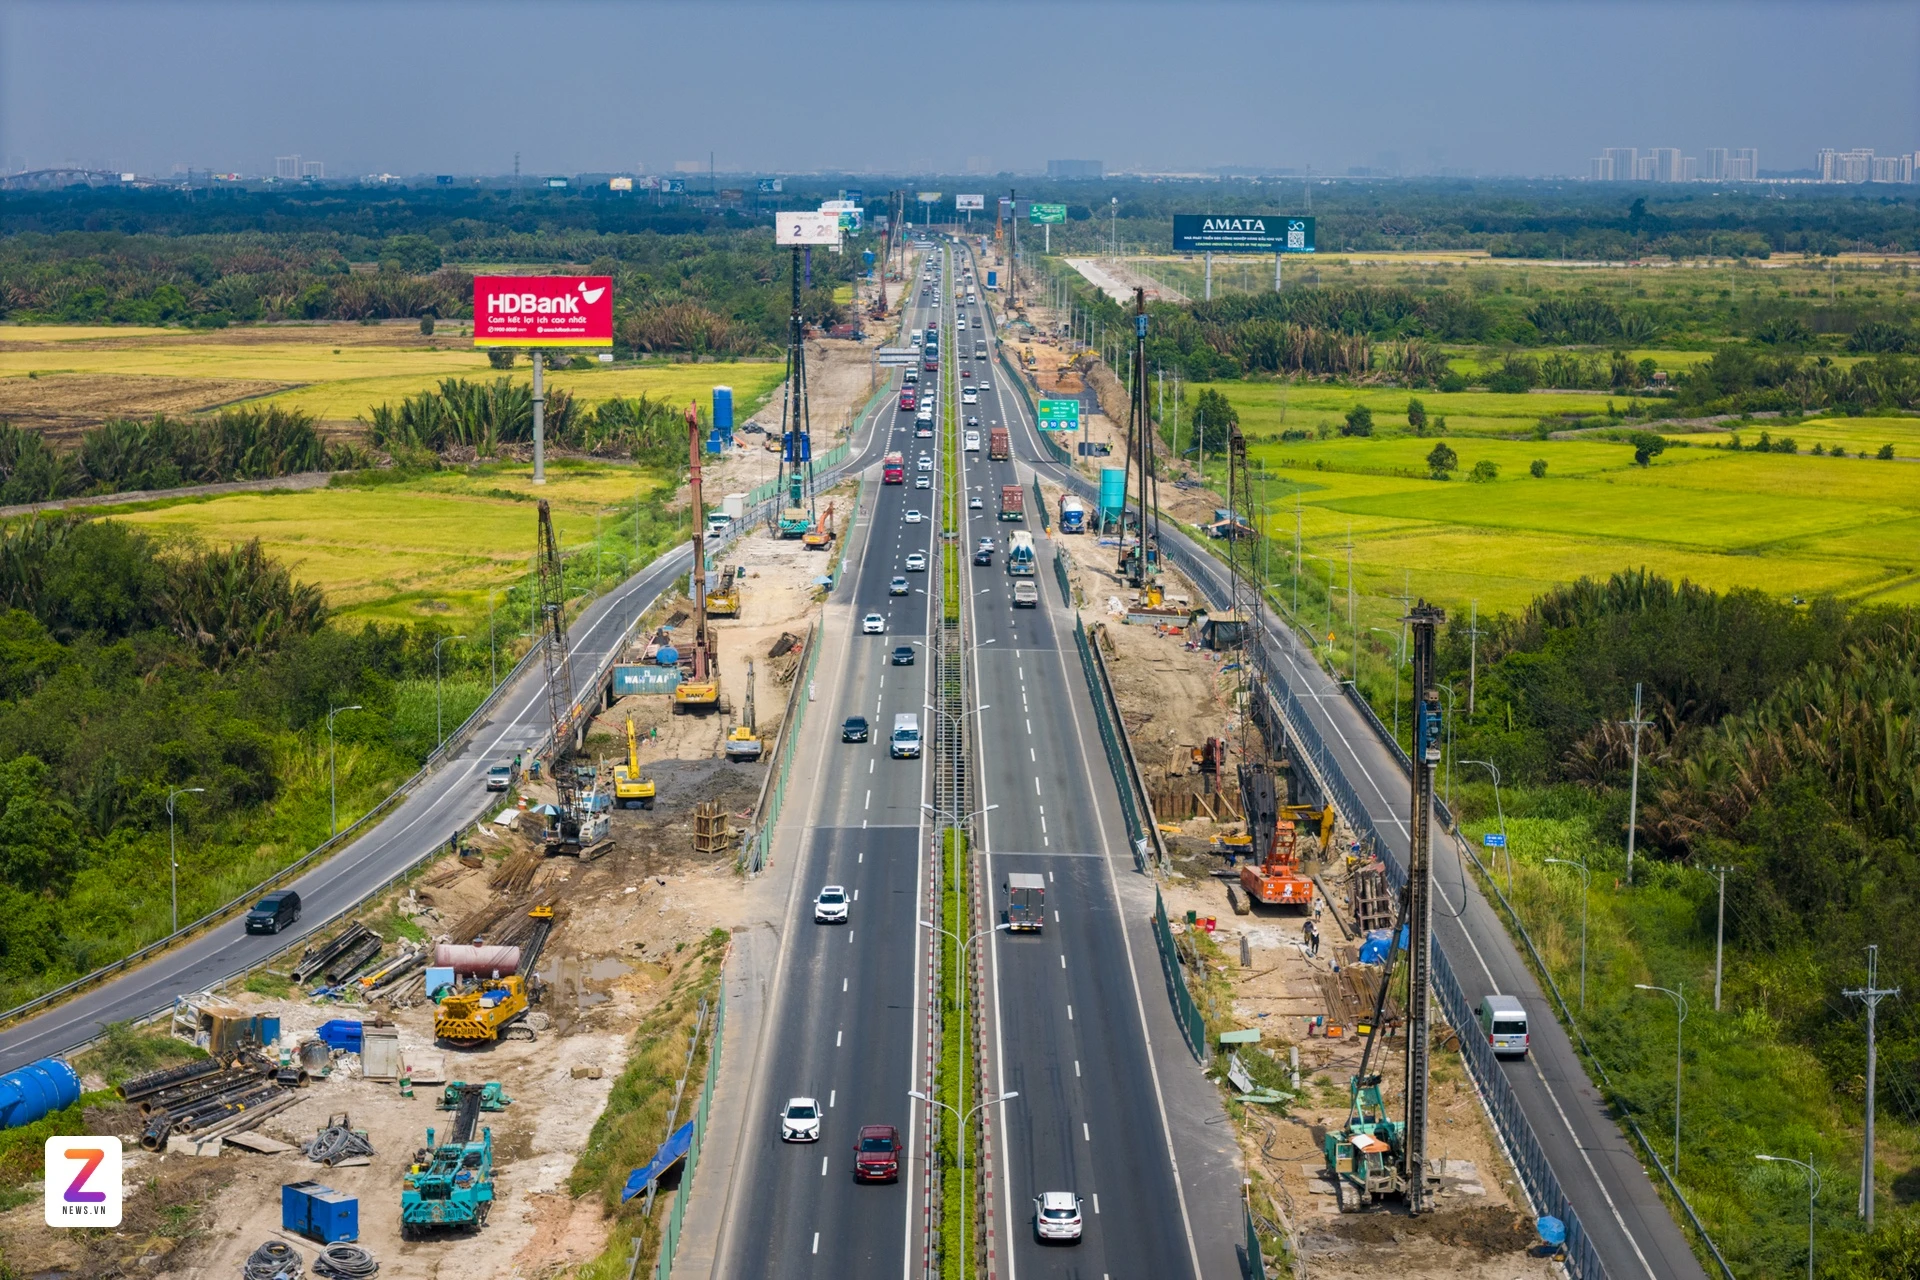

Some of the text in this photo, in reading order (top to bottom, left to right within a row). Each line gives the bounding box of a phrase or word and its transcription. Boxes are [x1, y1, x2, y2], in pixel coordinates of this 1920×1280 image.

[1202, 219, 1265, 229] AMATA
[794, 225, 802, 236] 2
[488, 294, 579, 314] HDBank
[524, 316, 534, 324] lợi
